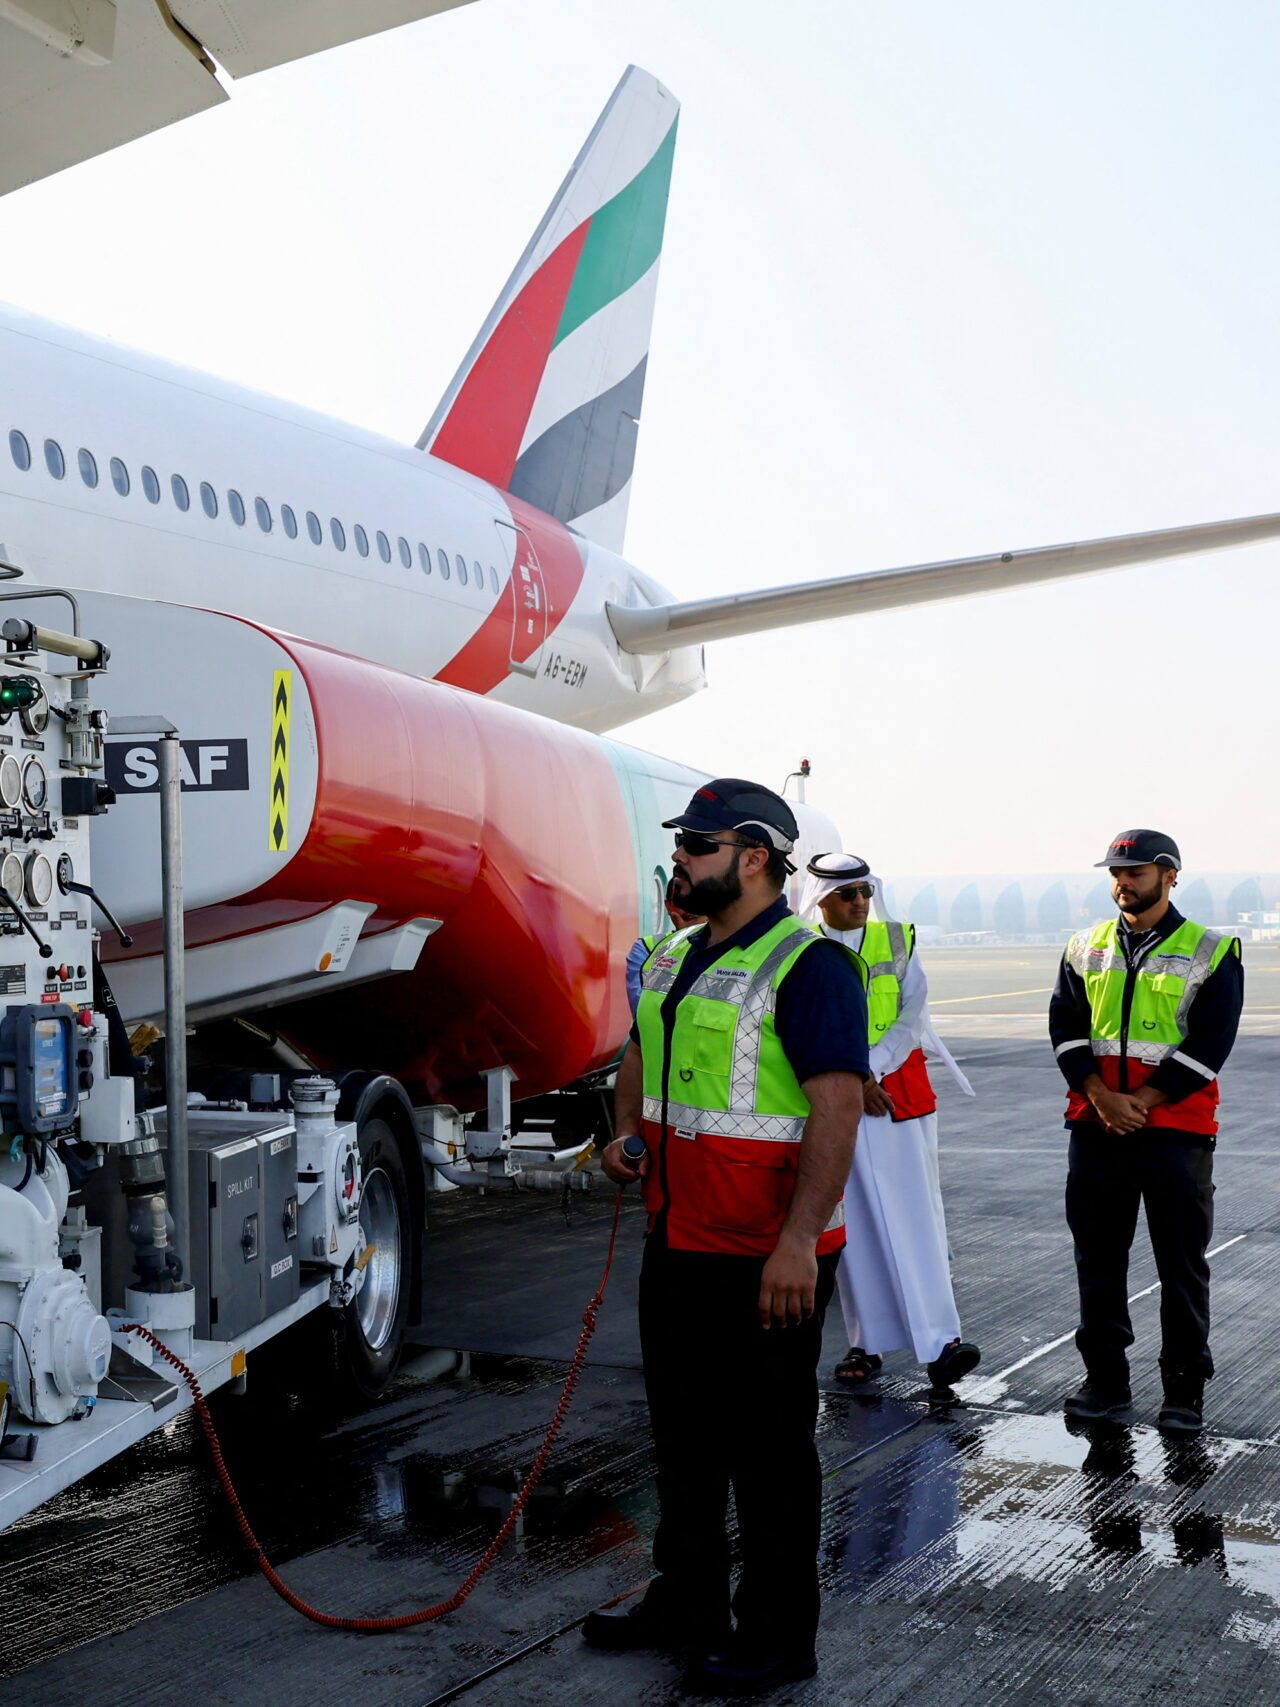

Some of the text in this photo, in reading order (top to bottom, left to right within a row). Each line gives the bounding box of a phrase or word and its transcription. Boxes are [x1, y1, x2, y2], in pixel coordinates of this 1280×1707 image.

[544, 652, 588, 688] A6-EBM
[227, 1176, 254, 1198] SPILL KIT
